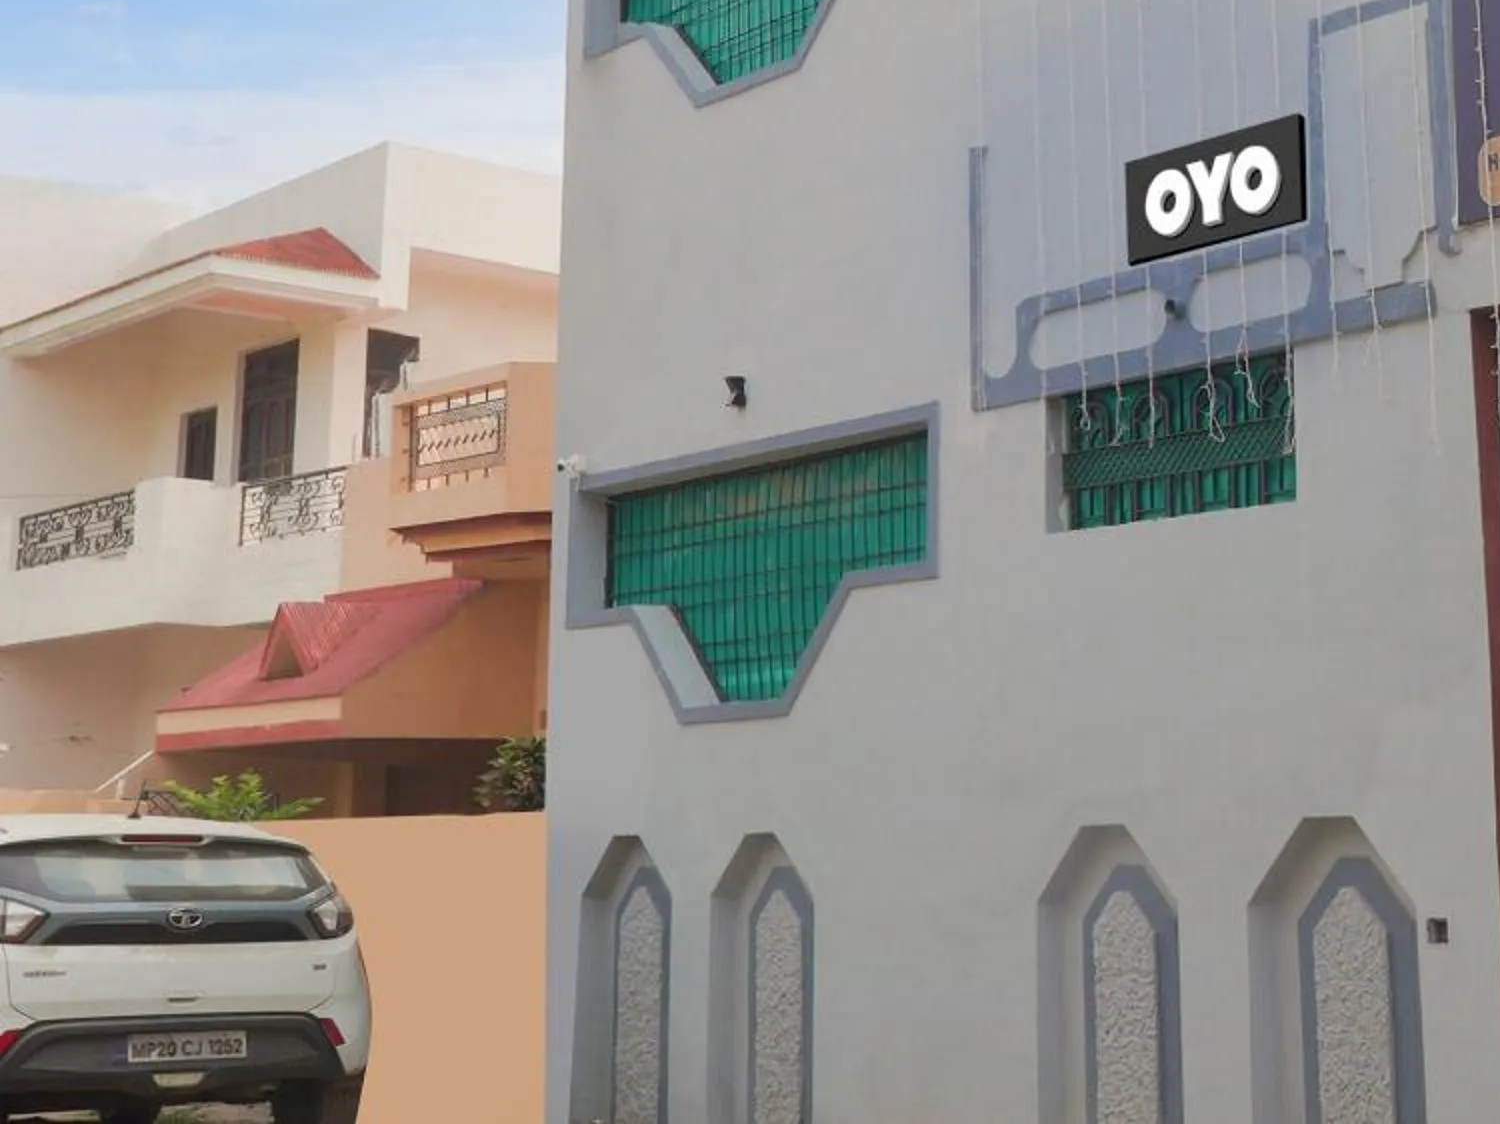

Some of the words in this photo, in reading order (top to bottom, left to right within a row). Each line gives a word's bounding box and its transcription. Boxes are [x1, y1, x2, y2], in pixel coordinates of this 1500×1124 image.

[1145, 144, 1281, 237] OYO
[131, 1040, 177, 1059] MP20
[181, 1039, 203, 1056] CJ
